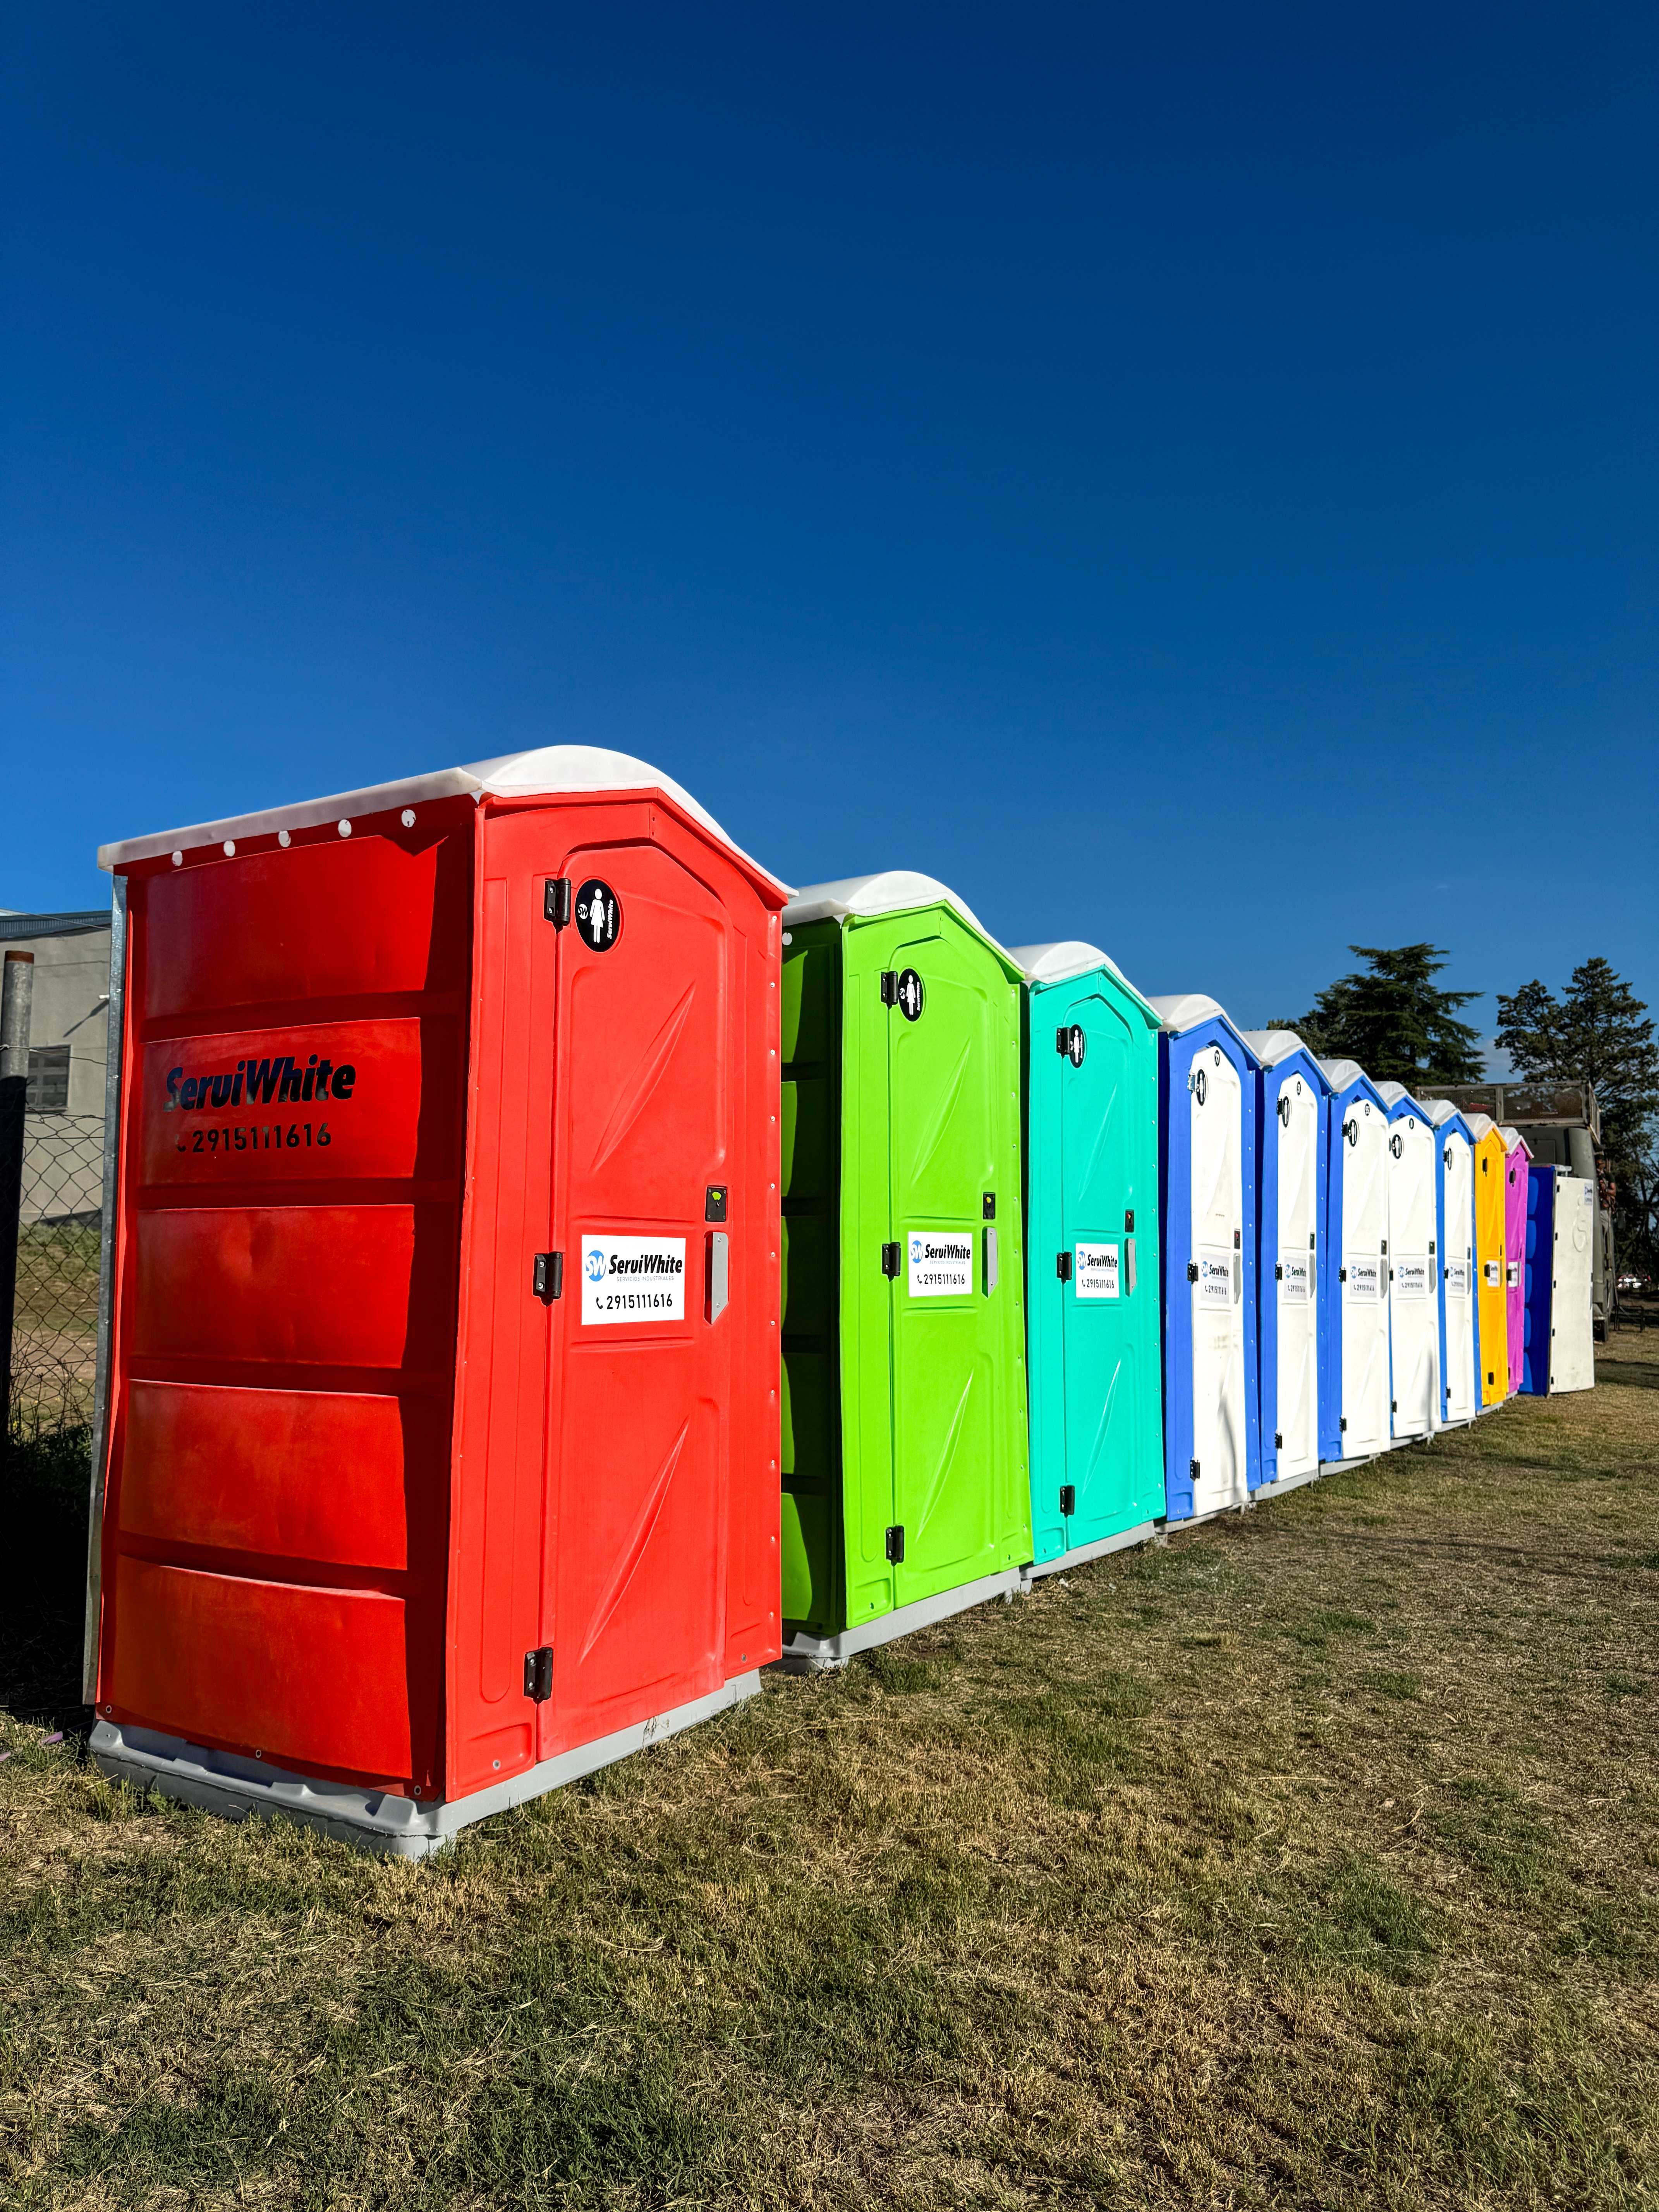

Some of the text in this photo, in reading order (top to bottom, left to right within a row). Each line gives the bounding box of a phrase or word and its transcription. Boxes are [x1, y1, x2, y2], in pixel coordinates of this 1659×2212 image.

[192, 1123, 331, 1153] 2915111616
[924, 1274, 965, 1285] 2915111616
[1087, 1279, 1114, 1288] 2915111616
[606, 1293, 672, 1310] 2915111616
